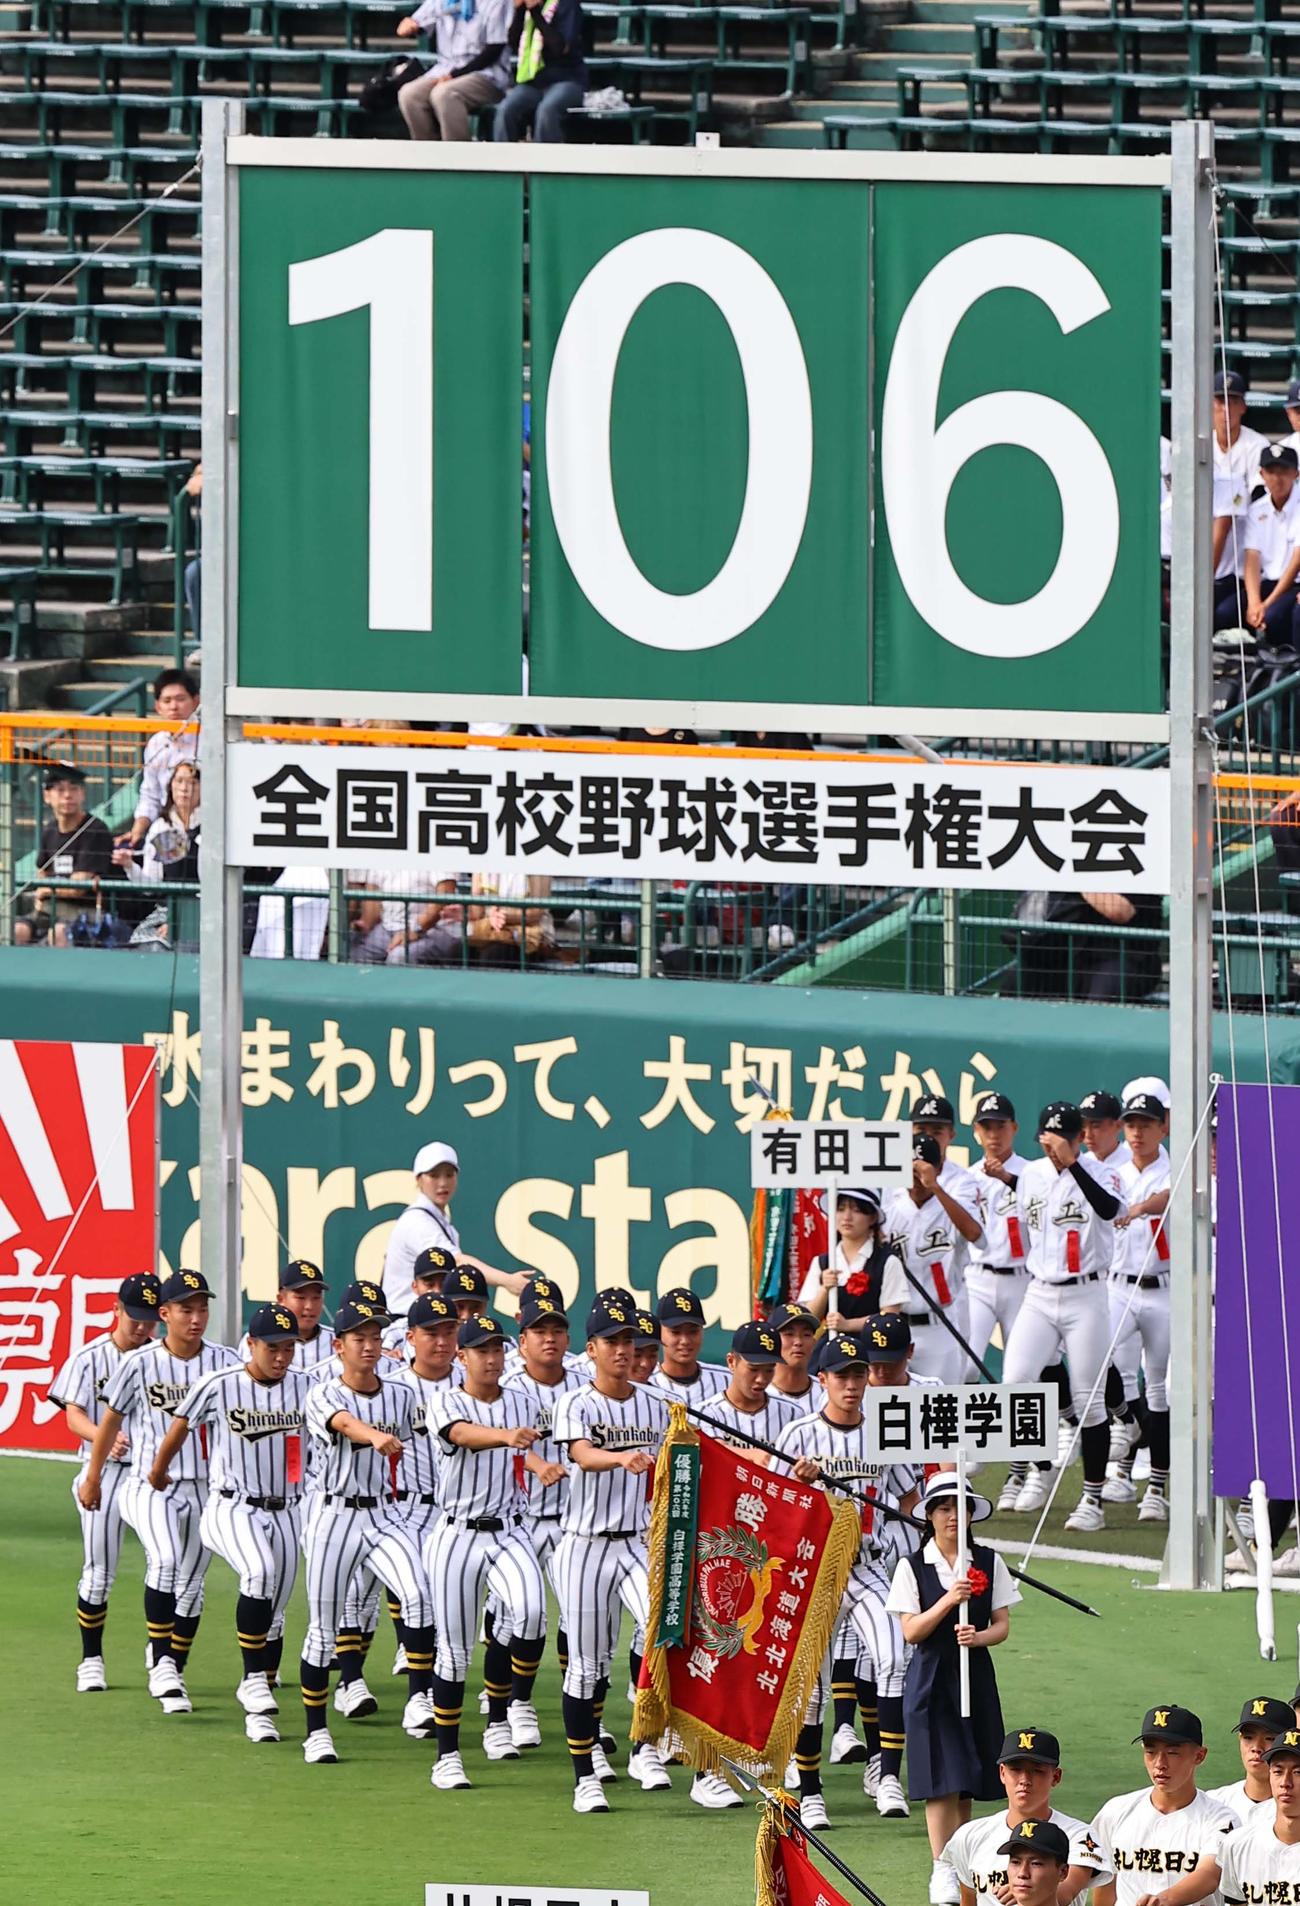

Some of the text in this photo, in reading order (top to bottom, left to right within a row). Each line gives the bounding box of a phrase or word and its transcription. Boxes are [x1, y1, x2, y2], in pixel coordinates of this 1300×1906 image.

[287, 226, 1121, 659] 106
[252, 763, 1149, 877] 全国高校野球選手権大会
[761, 1126, 904, 1176] 有田工
[590, 1423, 660, 1447] Shirakaba
[878, 1392, 1046, 1451] 白樺学園
[674, 1453, 692, 1484] 優勝
